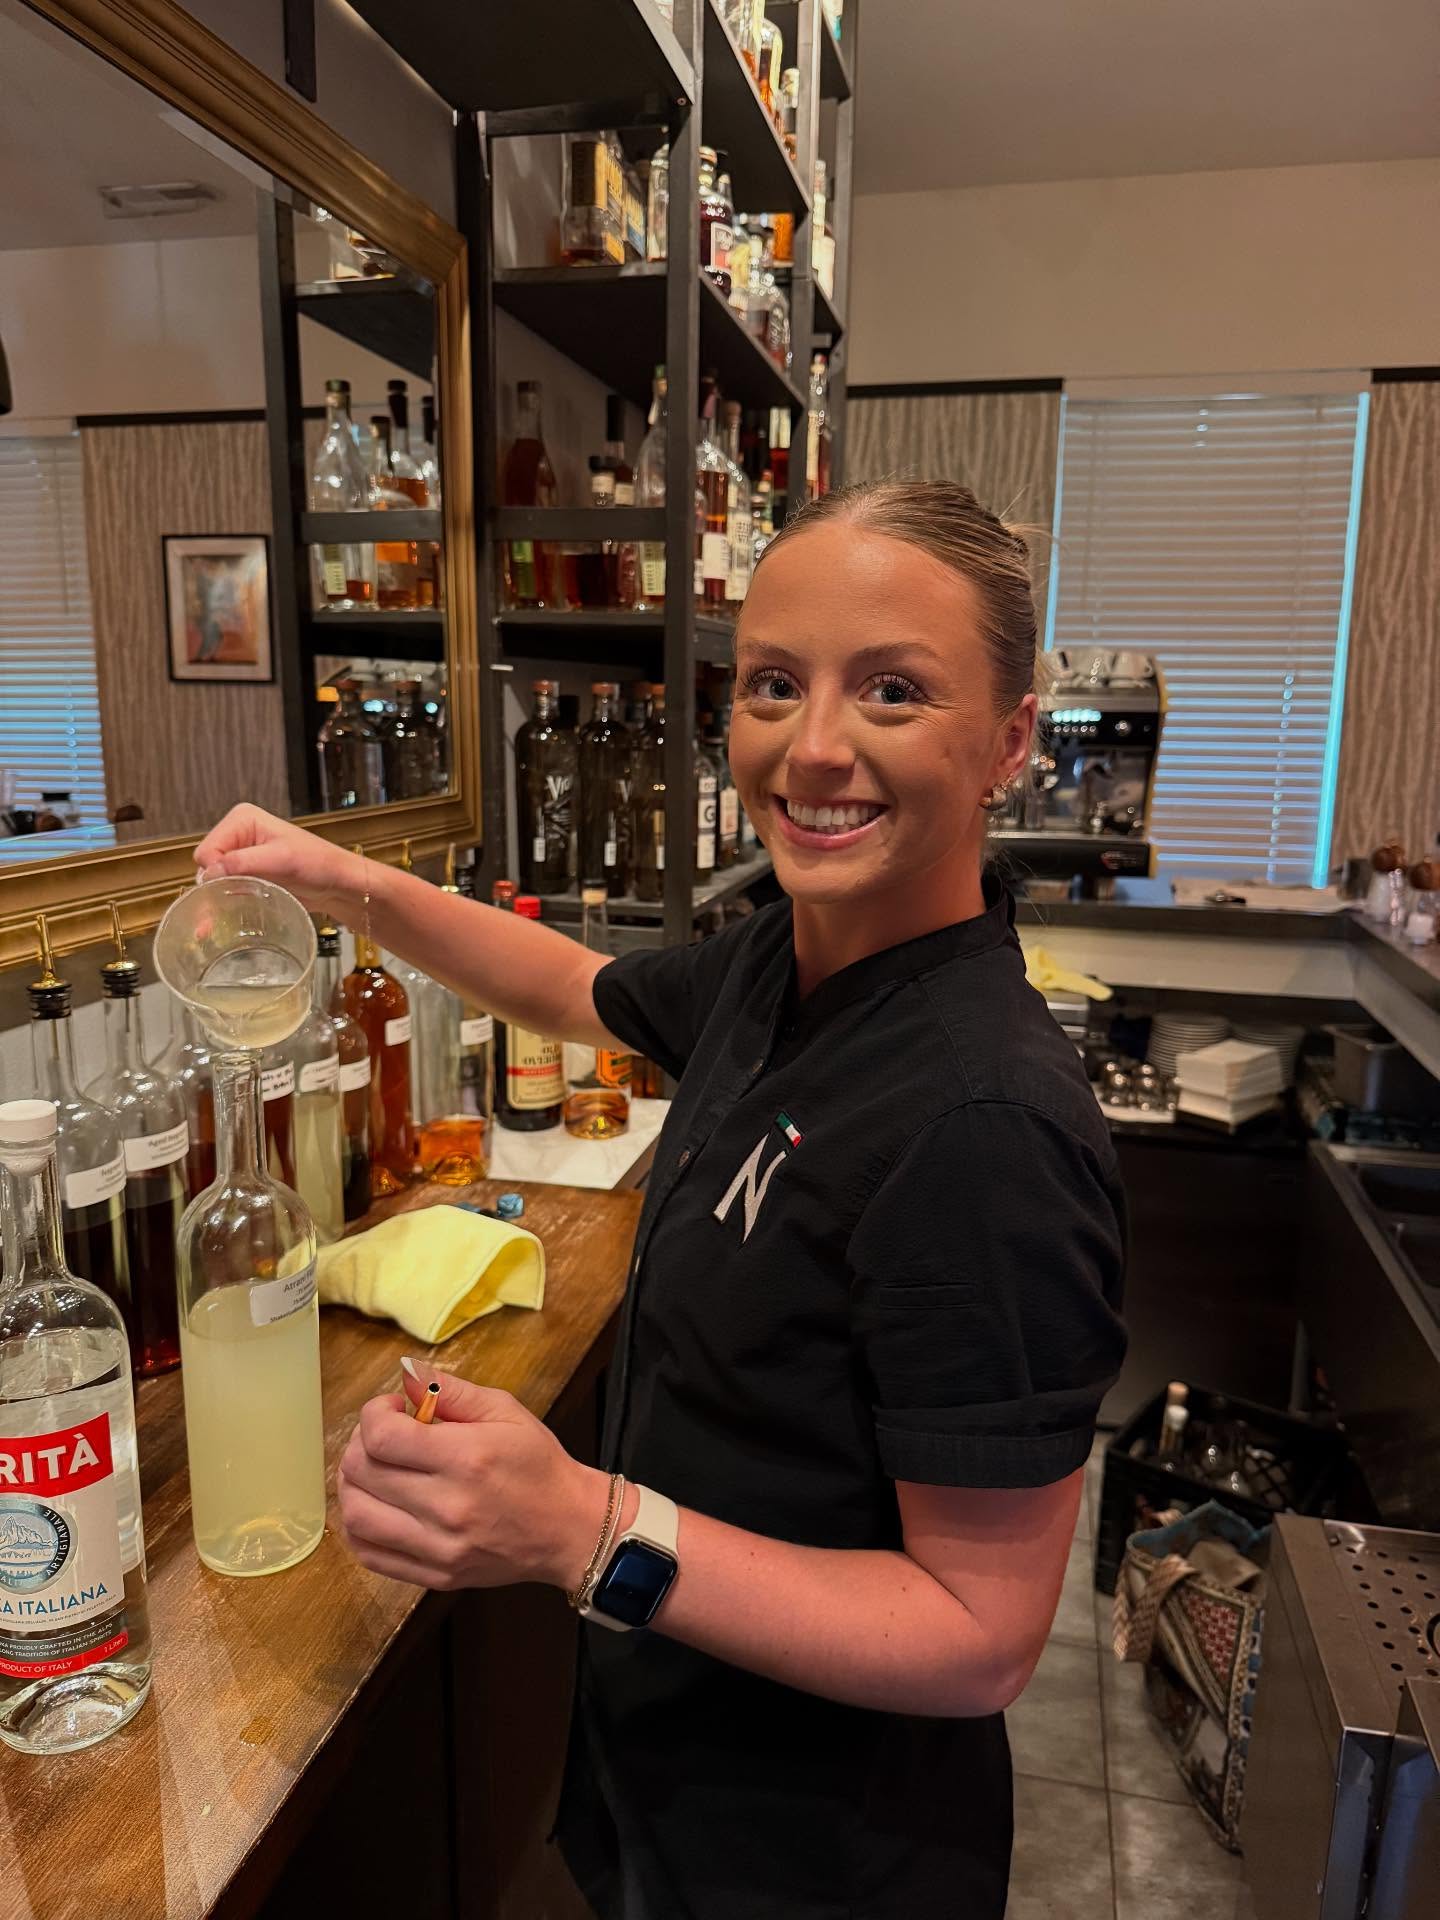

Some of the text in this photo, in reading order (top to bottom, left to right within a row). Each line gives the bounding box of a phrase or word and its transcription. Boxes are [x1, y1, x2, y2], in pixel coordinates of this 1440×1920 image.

[712, 1132, 788, 1244] N
[43, 1509, 68, 1576] ARTIGIANALE
[18, 1582, 108, 1615] ITALIANA
[10, 1643, 38, 1651] PROUDLY
[40, 1639, 72, 1650] CRAFTED
[83, 1631, 96, 1640] THE
[98, 1623, 113, 1633] ALPS
[61, 1641, 88, 1653] ITALIAN
[34, 1665, 47, 1673] OF
[49, 1661, 73, 1672] ITALY
